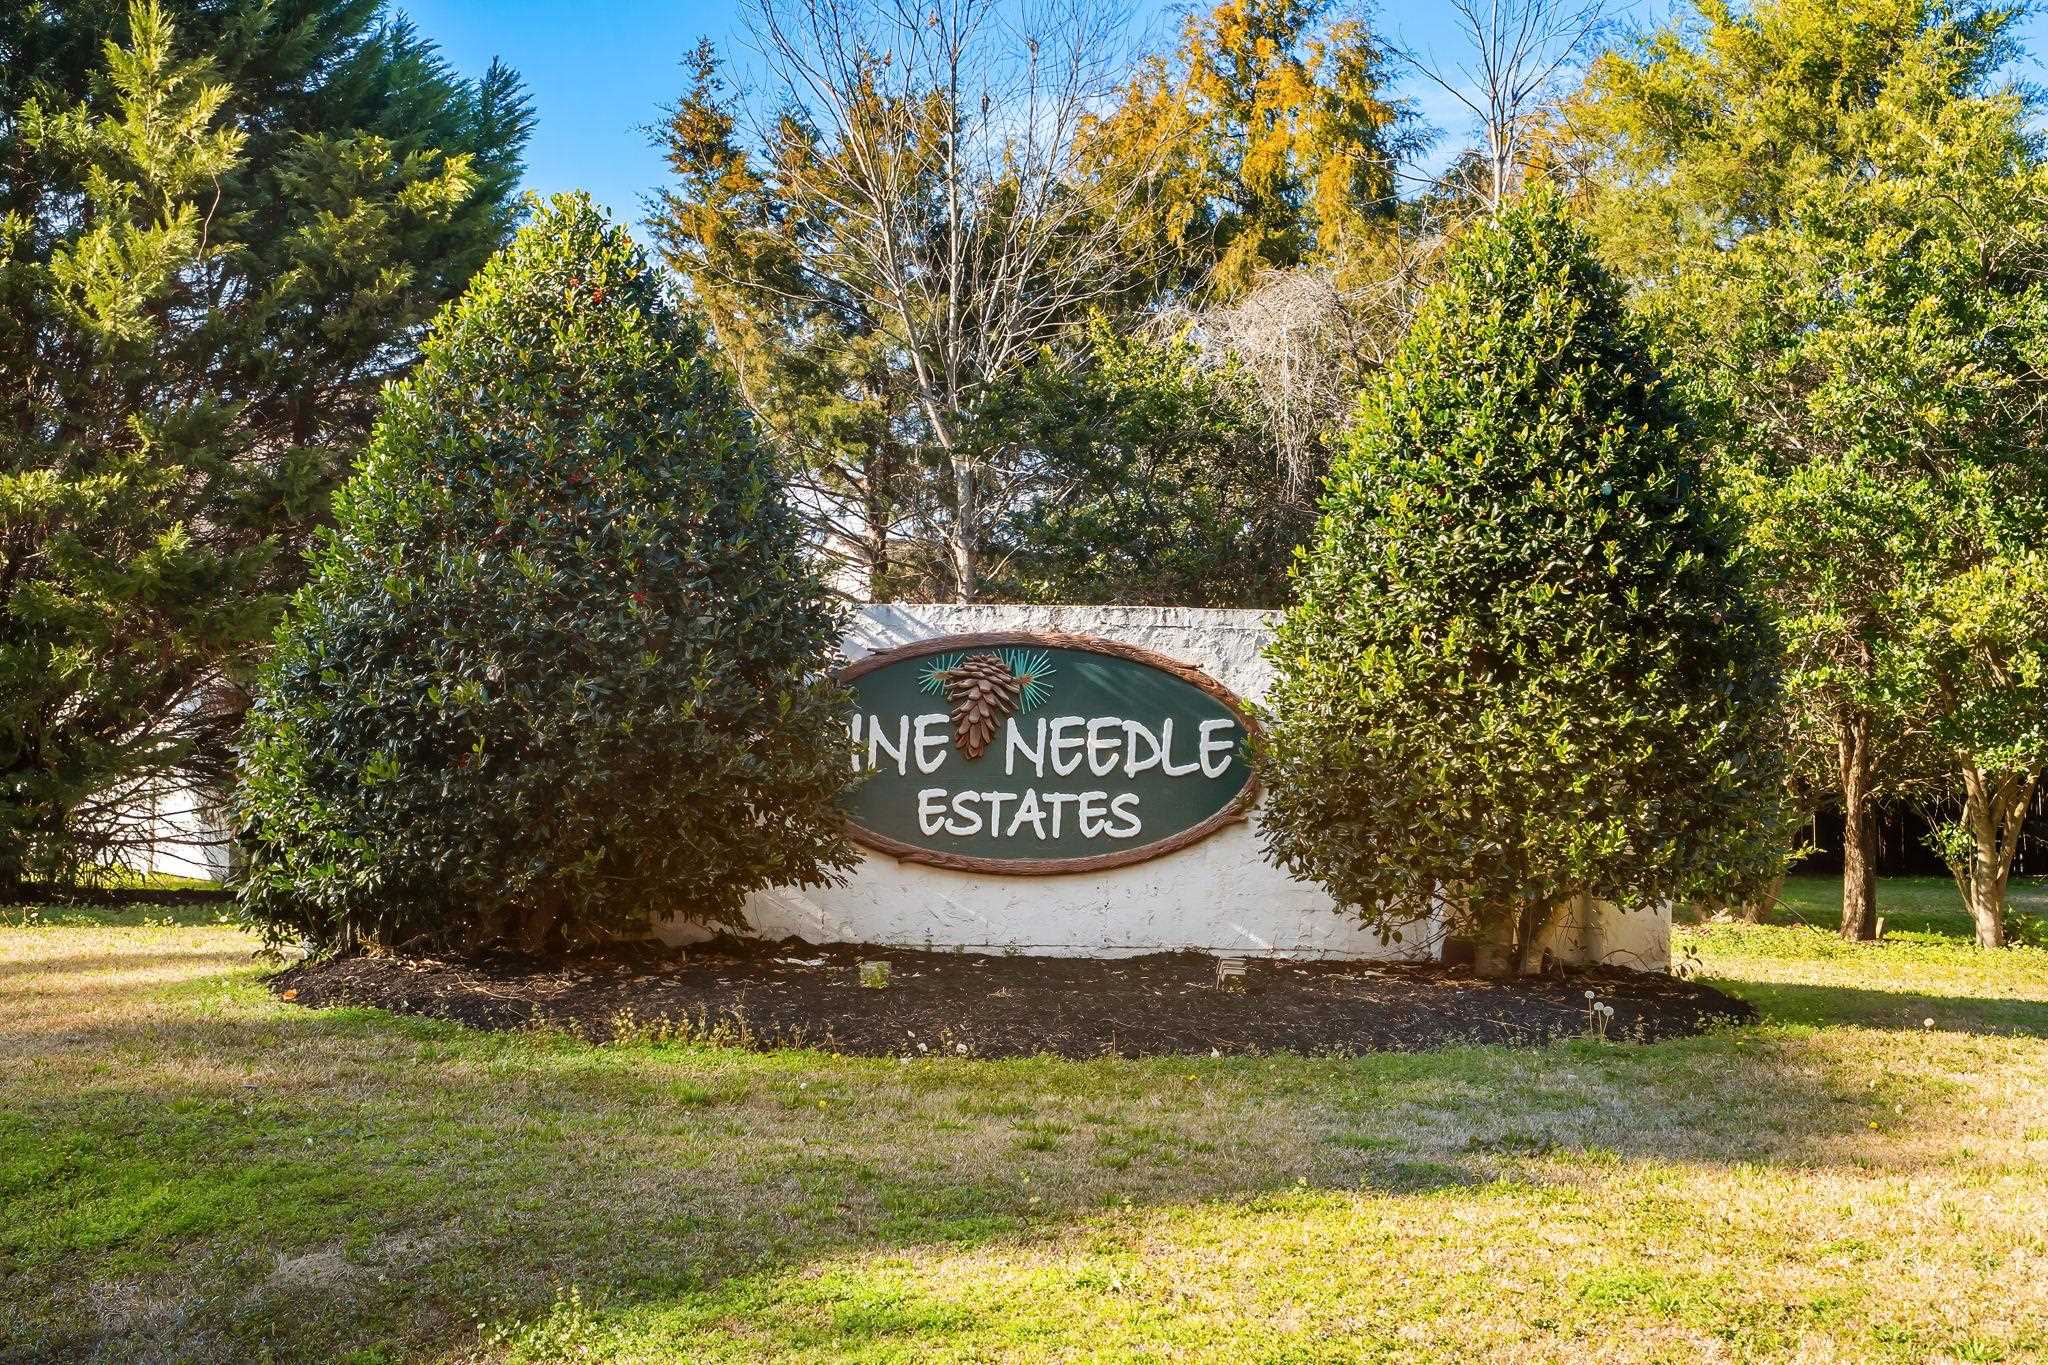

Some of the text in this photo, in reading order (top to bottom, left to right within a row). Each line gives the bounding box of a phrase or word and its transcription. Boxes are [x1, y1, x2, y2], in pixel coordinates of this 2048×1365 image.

[844, 713, 1235, 779] INE NEEDLE
[917, 787, 1142, 840] ESTATES
